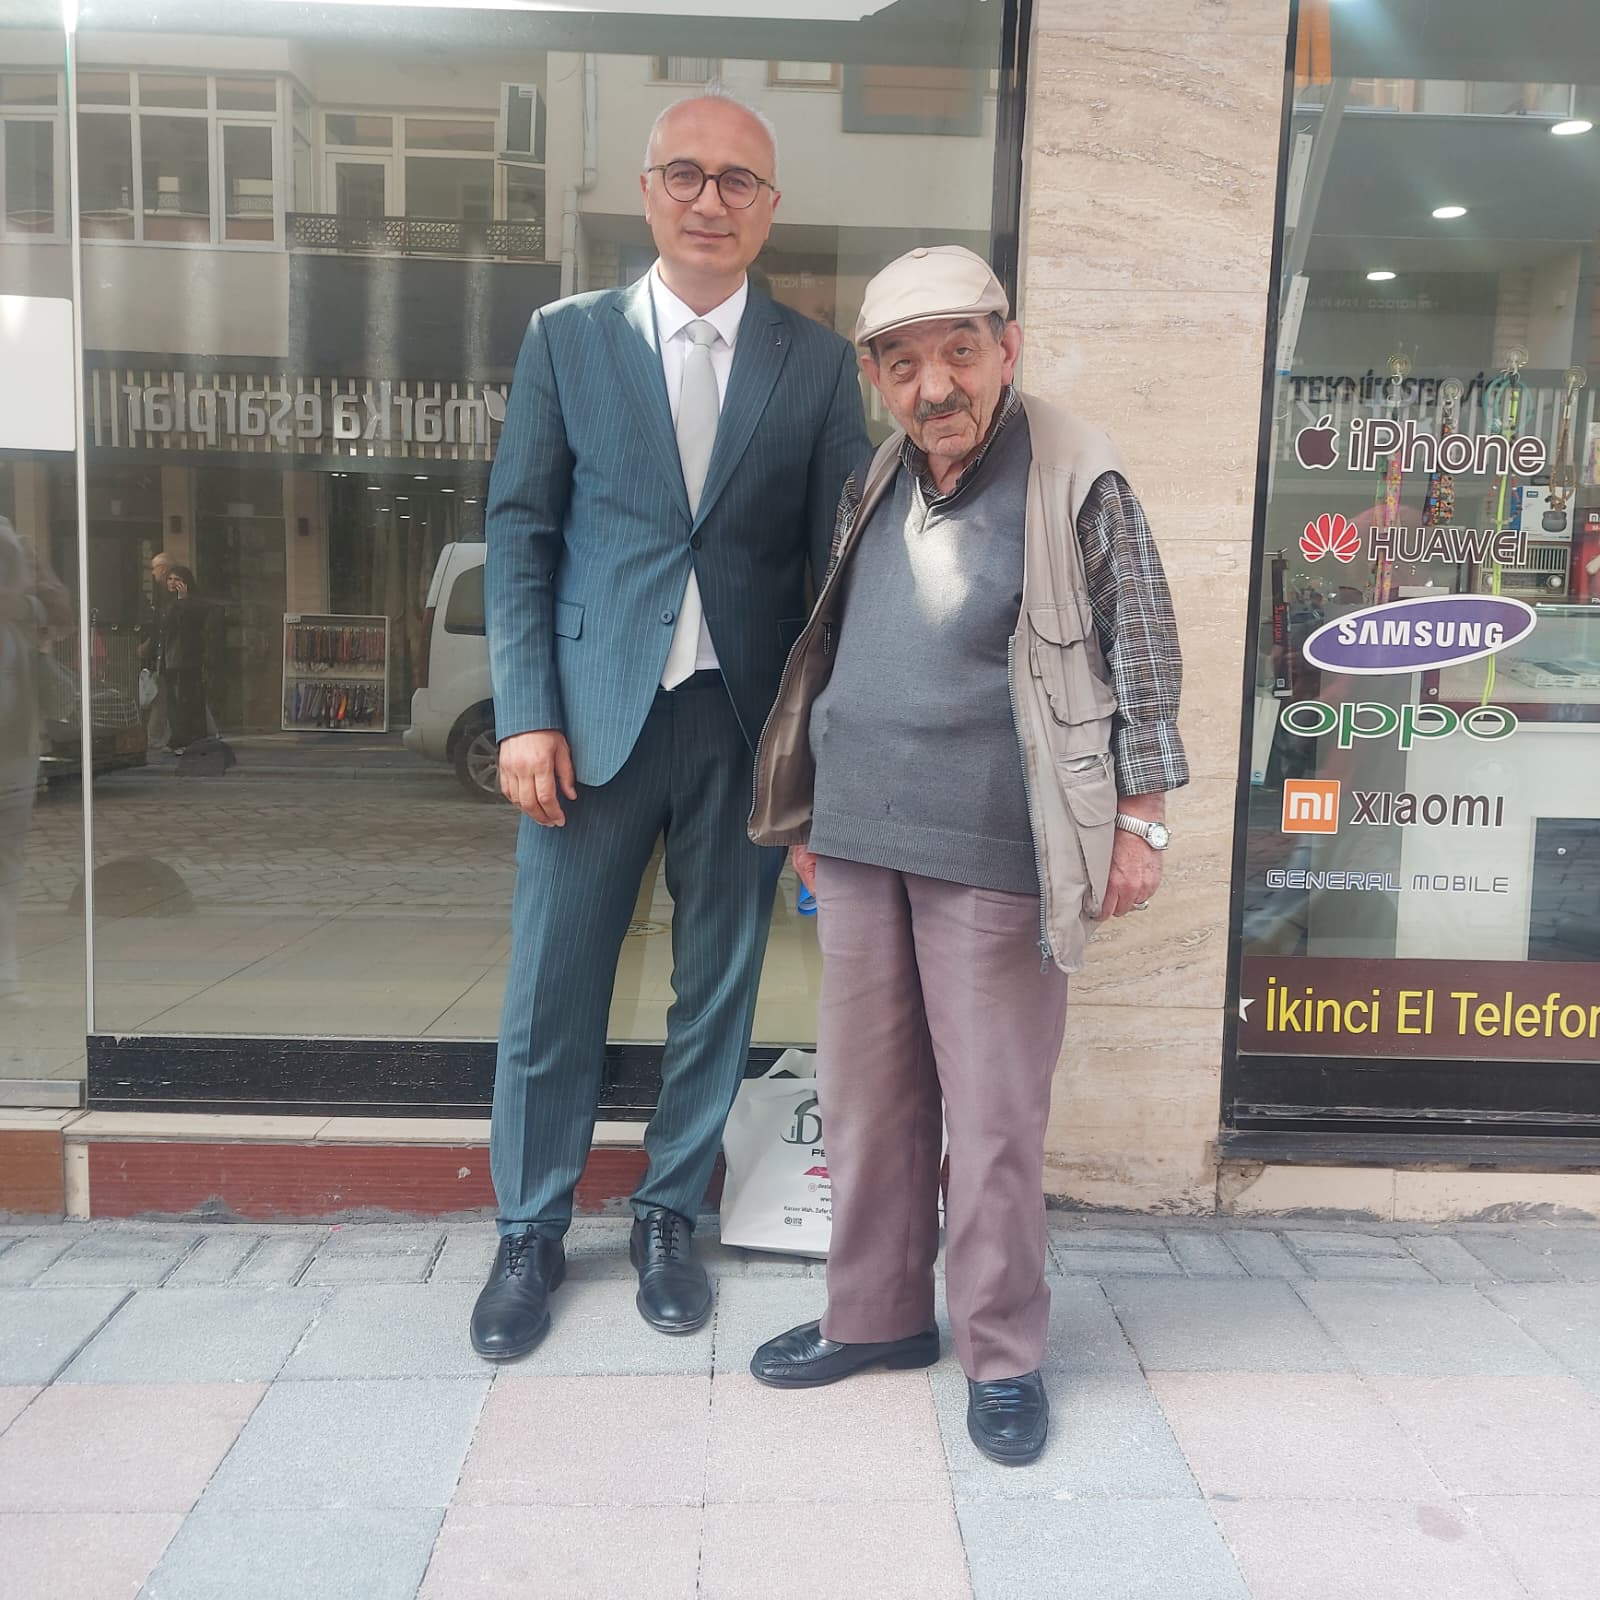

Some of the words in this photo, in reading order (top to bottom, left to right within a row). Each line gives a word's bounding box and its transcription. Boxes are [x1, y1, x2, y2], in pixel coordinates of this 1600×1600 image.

[1347, 417, 1547, 476] iPhone
[1367, 526, 1529, 566] HUAWEI
[1336, 619, 1505, 649] SAMSUNG
[1265, 868, 1403, 892] GENERAL
[1411, 874, 1510, 894] MOBILE
[1265, 975, 1382, 1035] İkinci
[1397, 988, 1435, 1035] El
